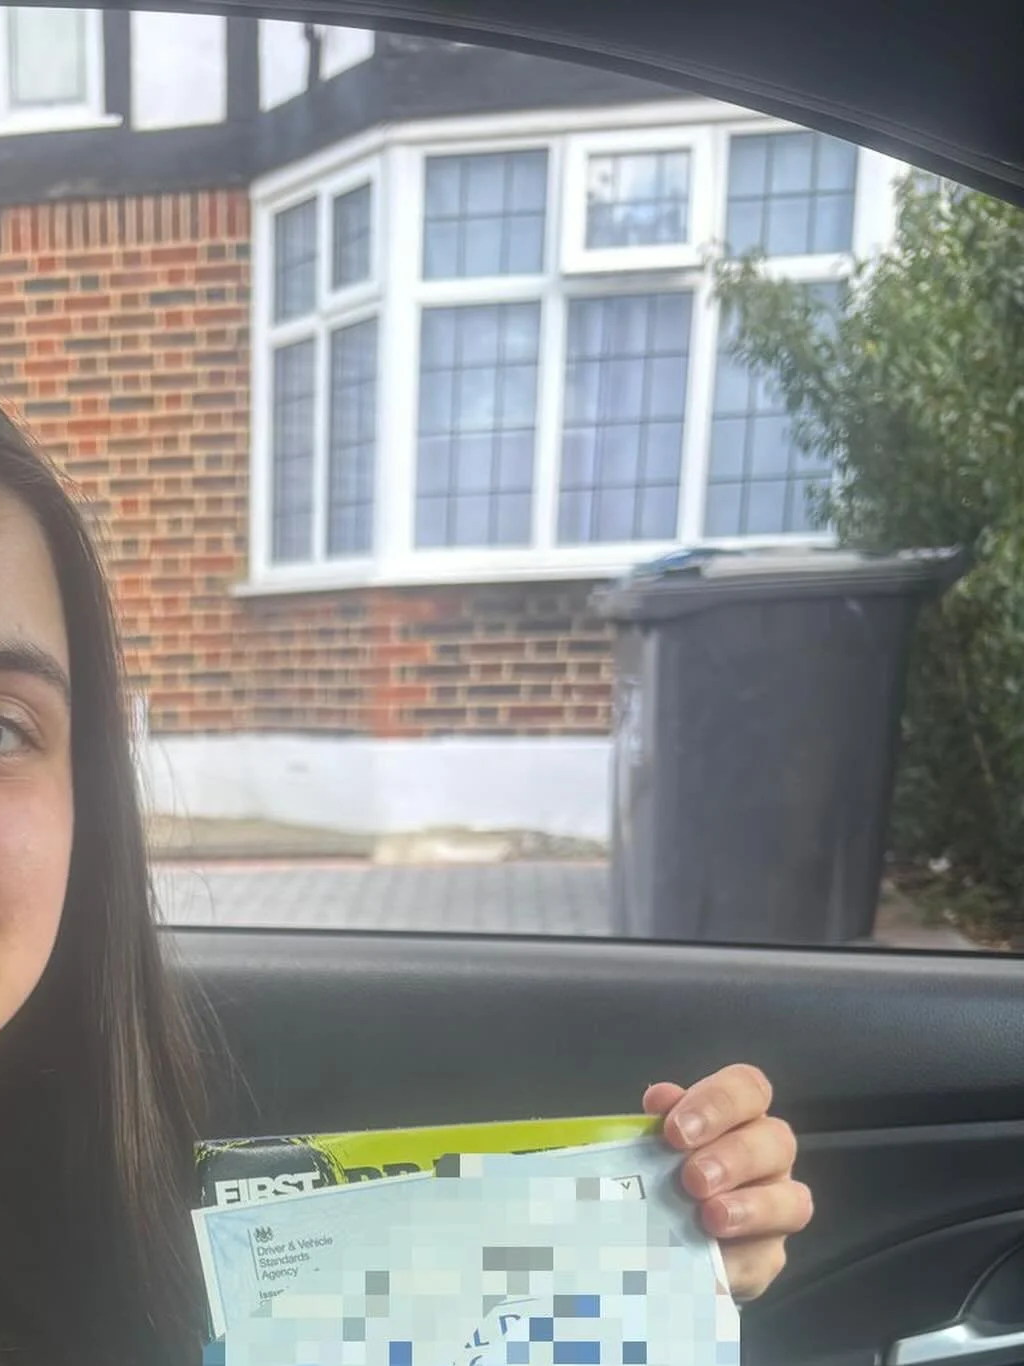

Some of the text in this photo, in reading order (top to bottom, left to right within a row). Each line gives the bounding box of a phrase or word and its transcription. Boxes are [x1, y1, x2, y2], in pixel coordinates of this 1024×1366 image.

[215, 1171, 321, 1206] FIRST
[257, 1236, 334, 1257] Driver & Vehicle
[259, 1252, 310, 1268] Standards
[262, 1267, 299, 1281] Agency
